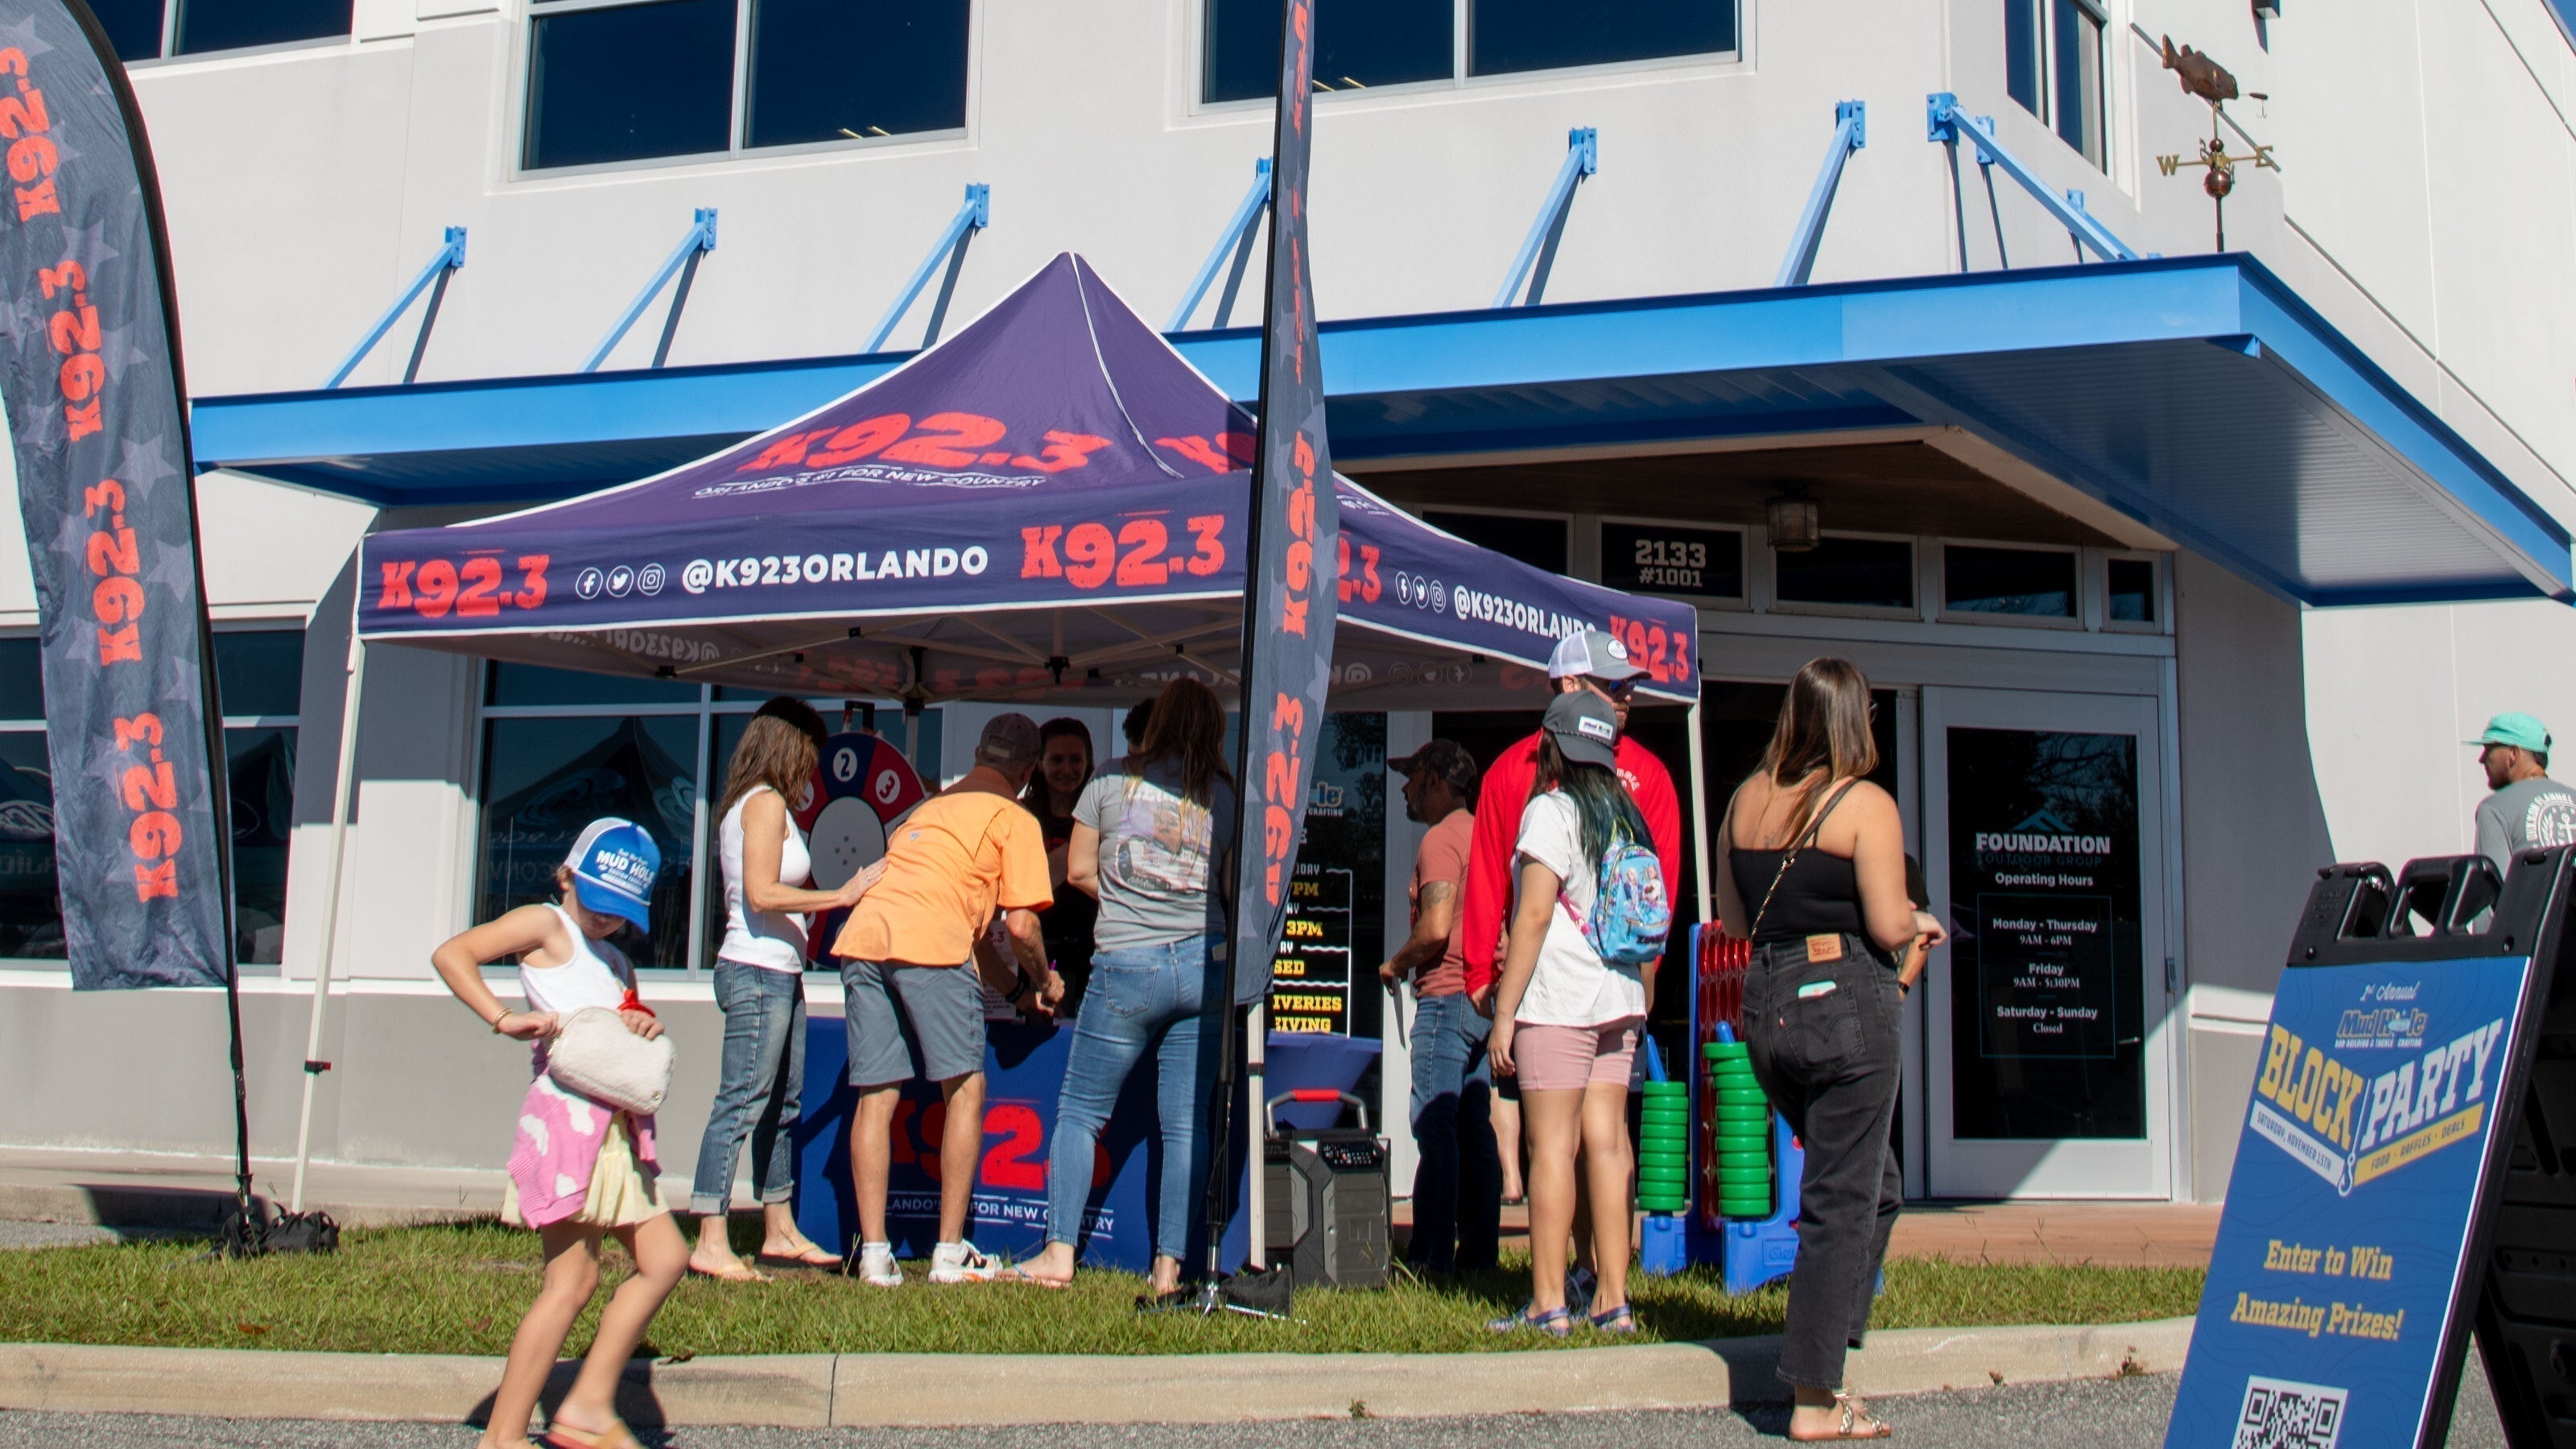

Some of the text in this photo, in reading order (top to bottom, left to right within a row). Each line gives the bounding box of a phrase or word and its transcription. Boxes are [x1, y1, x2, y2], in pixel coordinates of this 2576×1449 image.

[0, 47, 60, 223] K92.3
[2157, 146, 2273, 175] W E
[39, 258, 106, 443] K92.3
[736, 411, 1113, 473] K92.3
[838, 469, 885, 479] FOR
[887, 470, 939, 482] NEW
[942, 476, 1046, 488] COUNTRY
[1283, 430, 1316, 640] K92.3
[1635, 539, 1707, 568] 2133
[85, 477, 145, 667] K92.3
[378, 514, 1226, 619] K92.3 @K923ORLANDO K92.3
[1639, 567, 1703, 588] #1001
[1609, 614, 1688, 683] K92.3
[841, 753, 850, 778] 2
[879, 775, 895, 799] 3
[114, 711, 182, 903] K92.3
[1975, 832, 2111, 854] FOUNDATION
[596, 849, 630, 871] MUD
[1985, 853, 2102, 867] OUTDOOR GROUP
[1995, 873, 2093, 888] Operating Hours
[1286, 920, 1323, 936] 3PM
[1992, 919, 2037, 932] Monday
[2046, 919, 2097, 933] Thursday
[2020, 935, 2041, 945] 9AM
[2050, 935, 2072, 945] 6PM
[2029, 963, 2064, 976] Friday
[2013, 977, 2036, 988] 9AM
[2045, 977, 2079, 988] 5:30PM
[2376, 980, 2421, 1001] Annual
[1997, 1006, 2046, 1020] Saturday
[2057, 1006, 2098, 1020] Sunday
[2337, 1009, 2379, 1038] Mud
[2033, 1023, 2062, 1034] Closed
[2376, 1038, 2394, 1048] TACKLE
[2397, 1038, 2423, 1048] CRAFTING
[2258, 1018, 2504, 1150] BLOCK PARTY
[2256, 1110, 2332, 1172] SATURDAY, NOVEMBER 15TH
[2371, 1119, 2467, 1172] FOOD RAFFLES DEALS
[1004, 1204, 1038, 1220] NEW
[2264, 1239, 2394, 1281] Enter to Win
[2231, 1291, 2405, 1342] Amazing Prizes!
